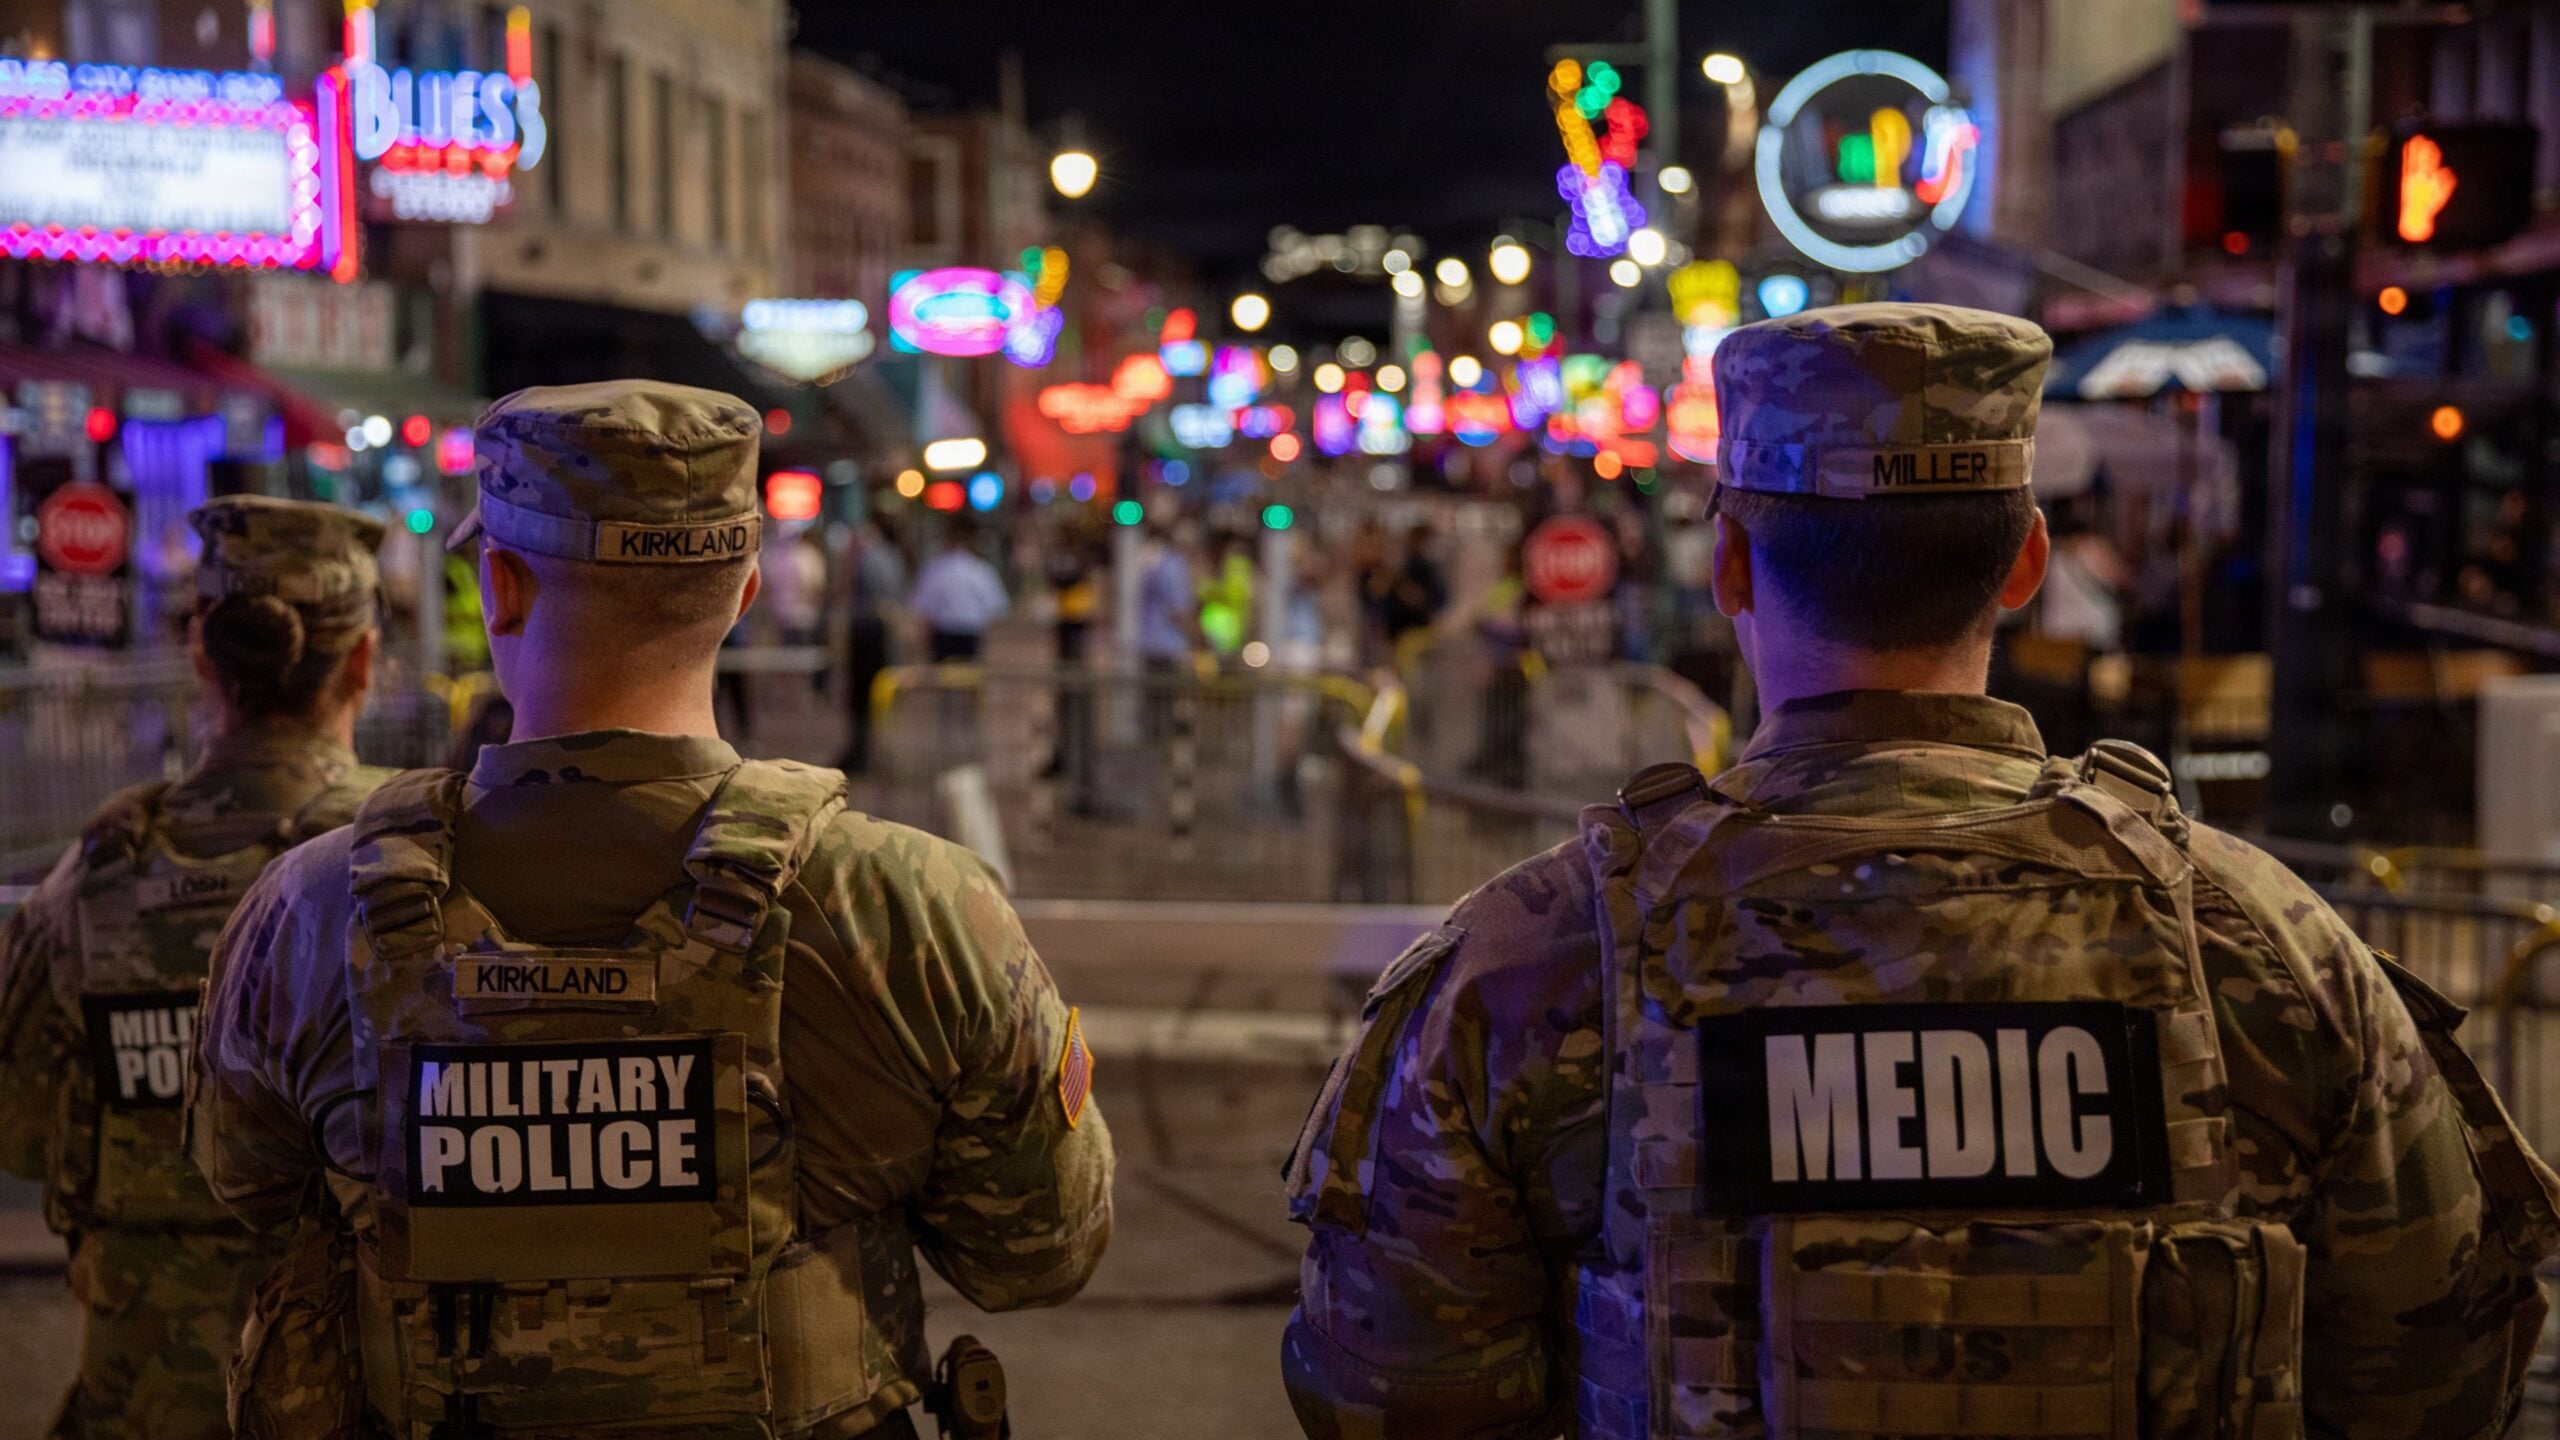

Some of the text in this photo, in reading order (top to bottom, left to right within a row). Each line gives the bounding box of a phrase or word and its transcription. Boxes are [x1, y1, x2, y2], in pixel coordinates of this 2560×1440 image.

[1872, 451, 1988, 486] MILLER
[619, 525, 748, 557] KIRKLAND
[476, 964, 629, 995] KIRKLAND
[419, 1054, 696, 1117] MILITARY
[1764, 1025, 2113, 1184] MEDIC
[419, 1119, 700, 1194] POLICE
